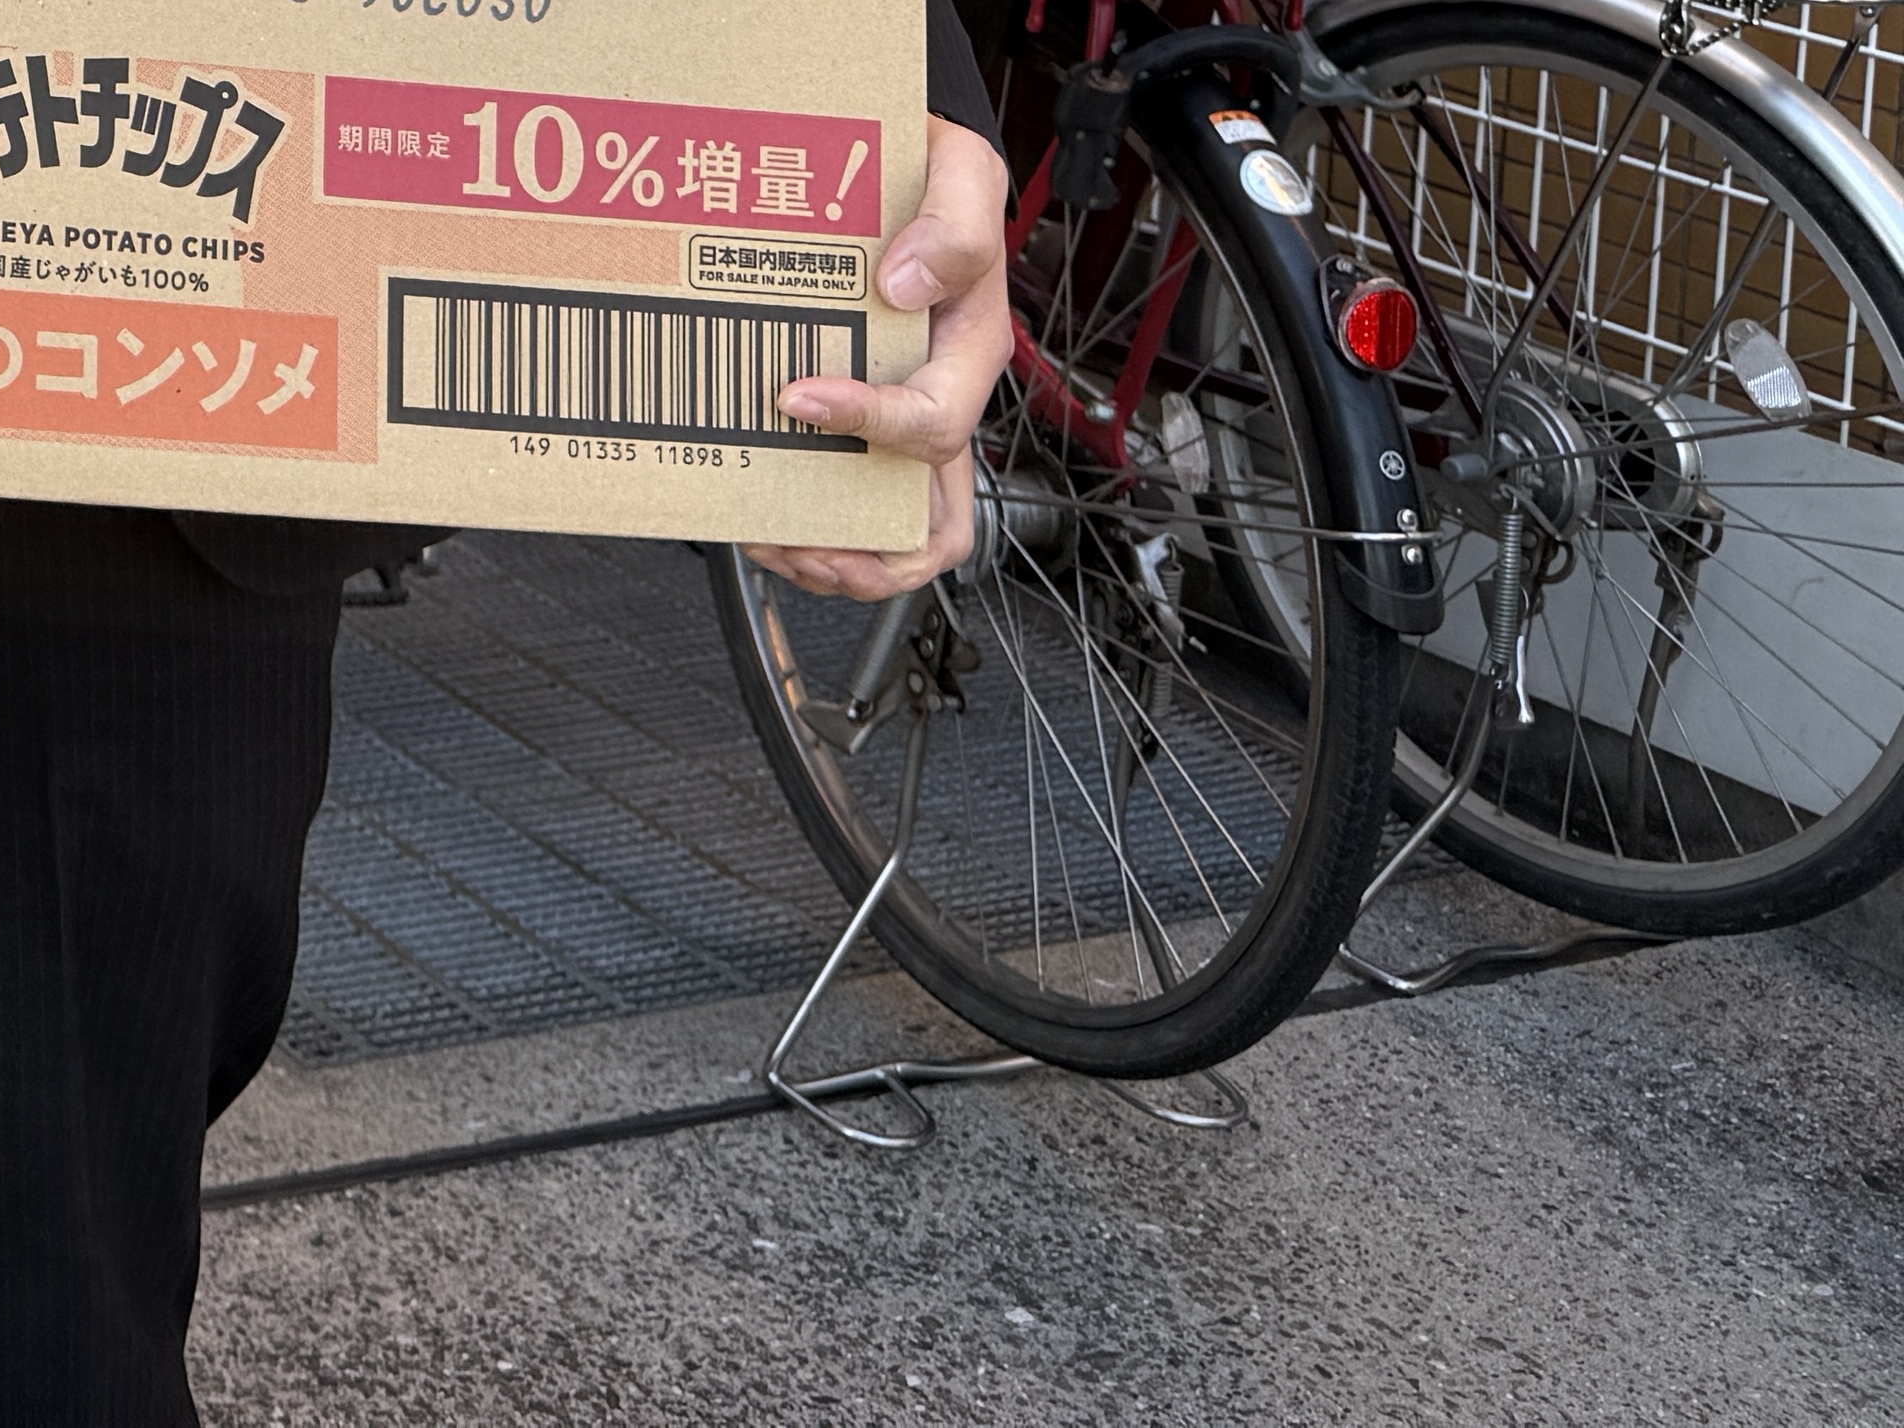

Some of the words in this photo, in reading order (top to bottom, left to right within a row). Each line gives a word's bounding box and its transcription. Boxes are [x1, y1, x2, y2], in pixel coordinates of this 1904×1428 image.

[337, 124, 452, 161] 期間限定
[64, 226, 175, 257] POTATO
[182, 236, 267, 265] CHIPS
[698, 245, 857, 278] 日本国内販売専用
[698, 270, 724, 284] FOR
[726, 272, 760, 286] SALE
[761, 274, 774, 286] IN
[777, 275, 820, 290] JAPAN
[821, 277, 857, 292] ONLY
[509, 434, 551, 457] 149
[567, 438, 638, 463] 01335
[654, 443, 725, 469] 11898
[739, 449, 752, 469] 5
